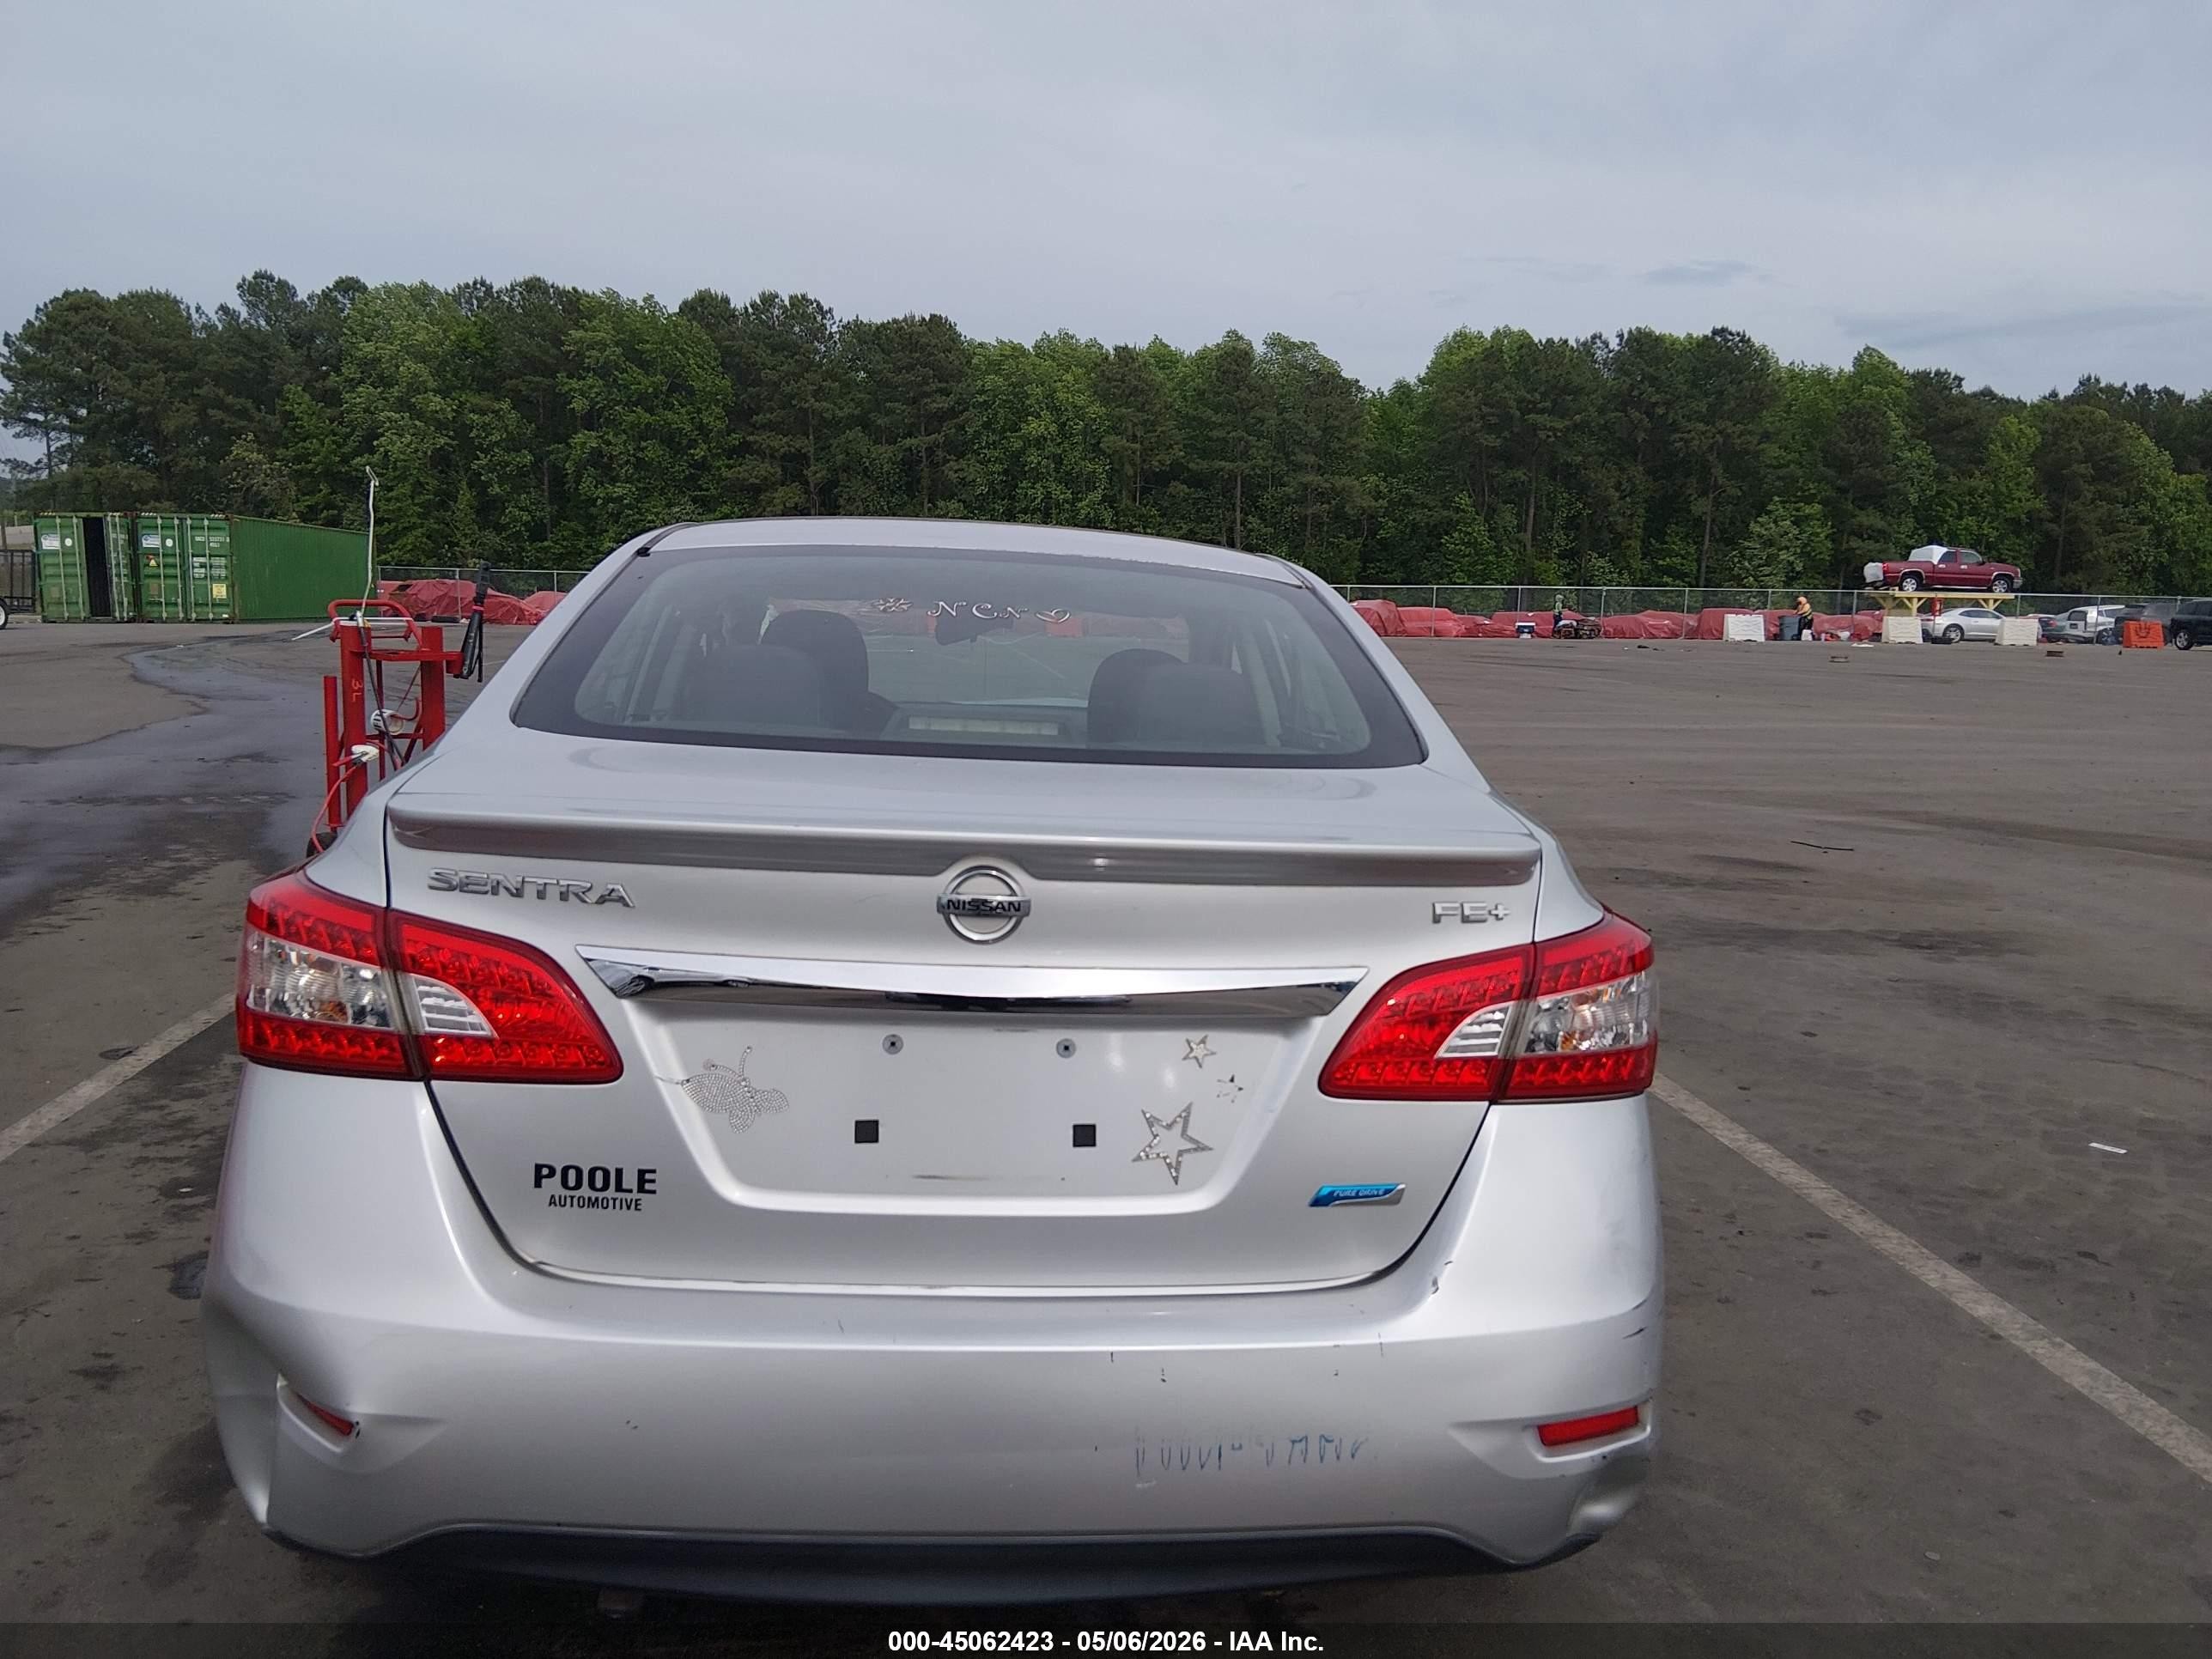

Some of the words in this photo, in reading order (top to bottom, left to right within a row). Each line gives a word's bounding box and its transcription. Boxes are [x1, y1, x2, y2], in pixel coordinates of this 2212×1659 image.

[428, 867, 635, 908] SENTRA
[946, 898, 1022, 913] NISSAN
[1431, 902, 1511, 924] FE+
[533, 1163, 657, 1194] POOLE
[548, 1194, 643, 1212] AUTOMOTIVE
